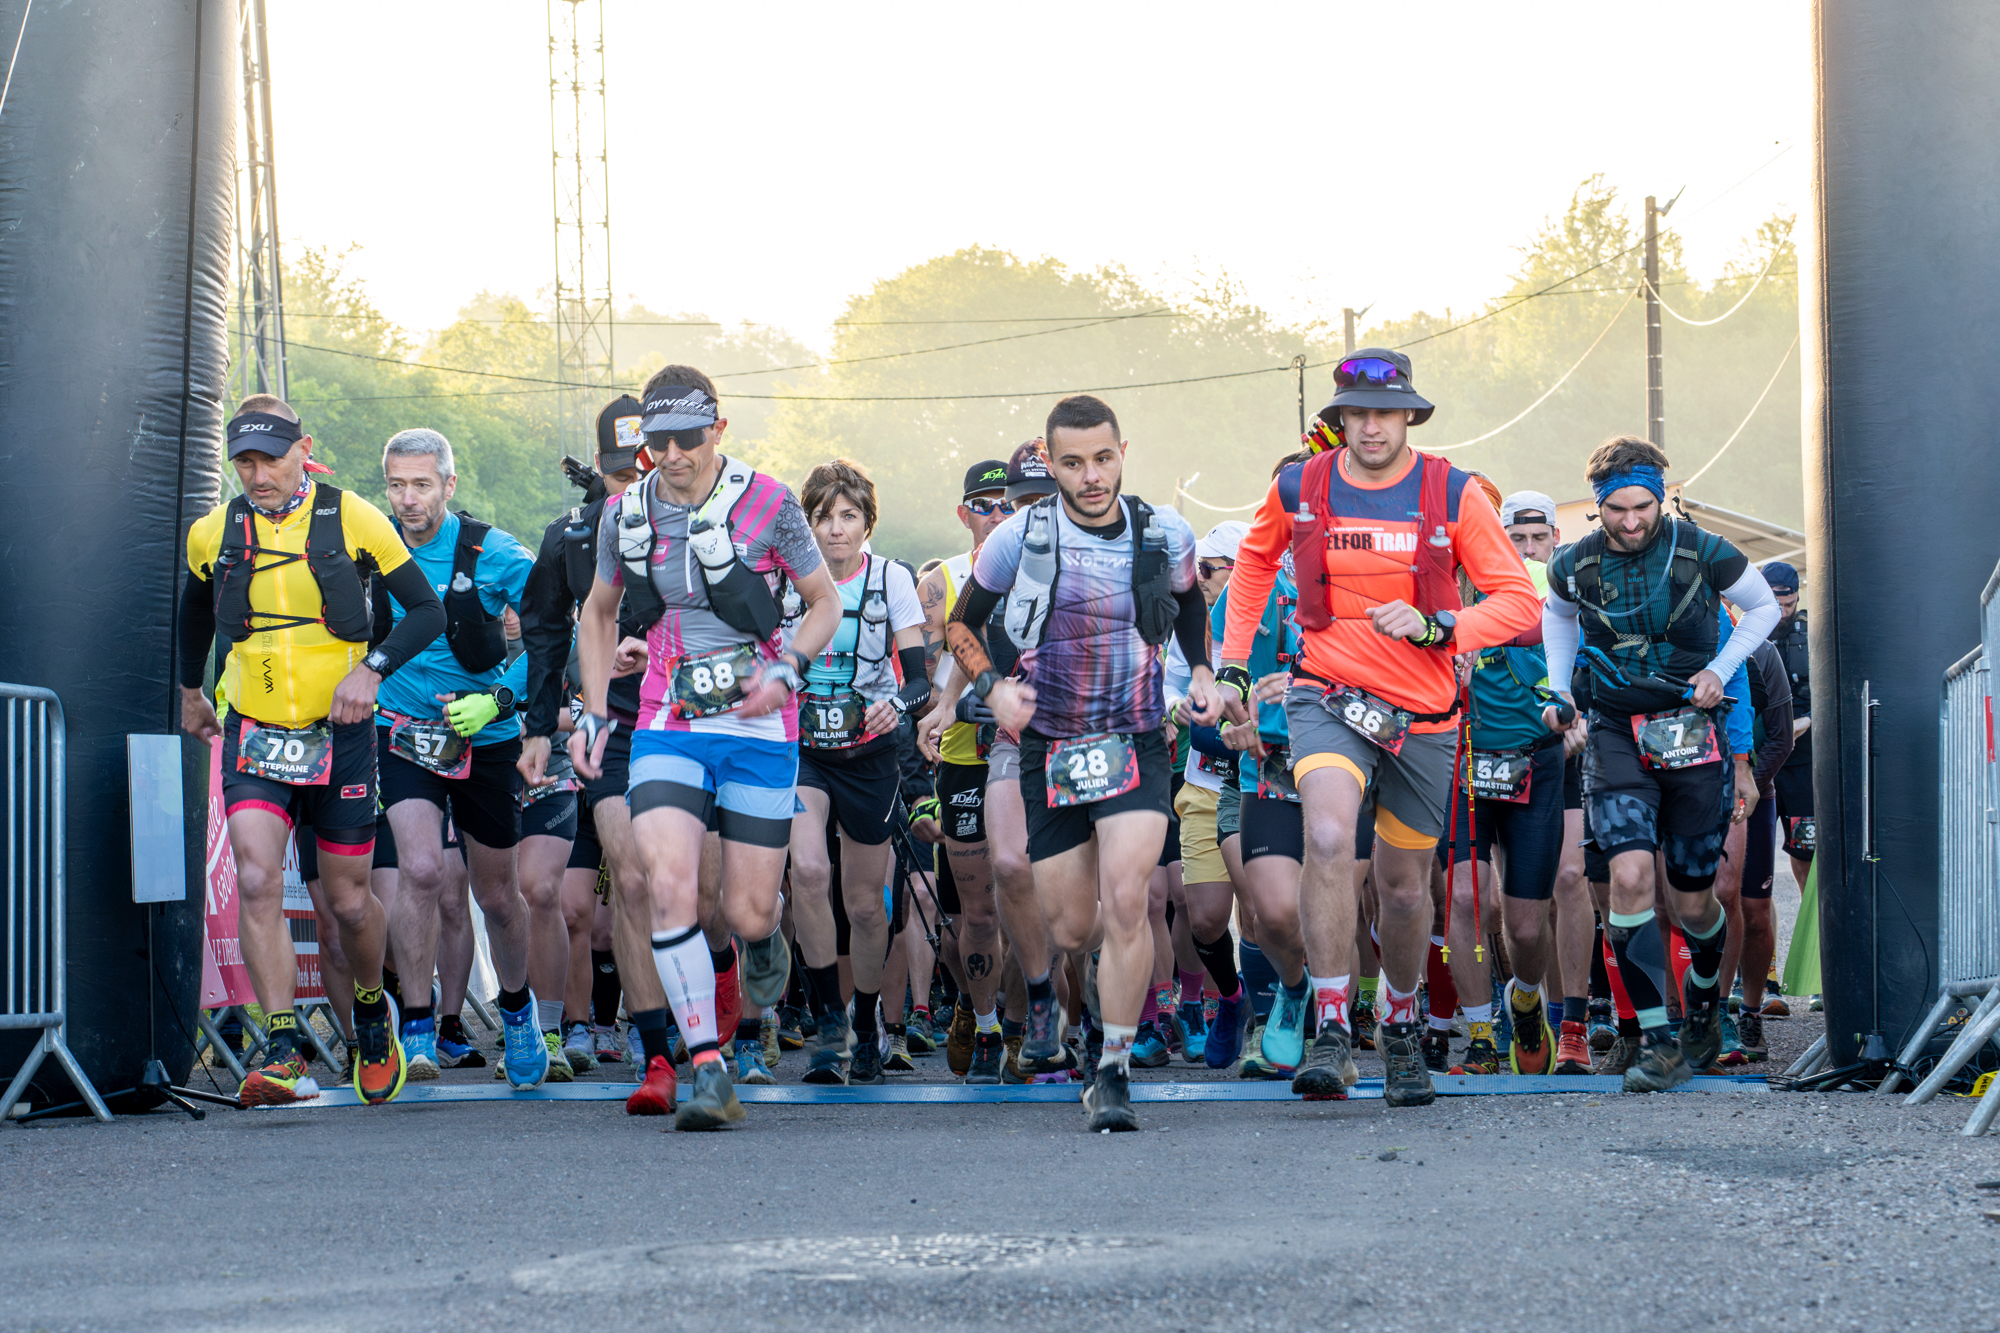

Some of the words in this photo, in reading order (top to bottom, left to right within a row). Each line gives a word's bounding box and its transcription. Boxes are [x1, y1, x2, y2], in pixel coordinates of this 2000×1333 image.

[645, 398, 710, 412] DYNAFIT
[239, 423, 274, 434] 2XU
[1627, 575, 1644, 583] kilpi
[692, 662, 735, 694] 88
[816, 708, 844, 730] 19
[1345, 702, 1383, 732] 86
[414, 732, 447, 756] 57
[813, 730, 849, 739] MELANIE
[1668, 723, 1684, 747] 7
[266, 737, 305, 762] 70
[419, 755, 439, 765] ERIC
[1662, 745, 1699, 760] ANTOINE
[258, 760, 309, 773] STEPHANE
[1068, 748, 1109, 780] 28
[1477, 759, 1511, 781] 54
[1075, 777, 1109, 791] JULIEN
[949, 787, 982, 808] 1Defy
